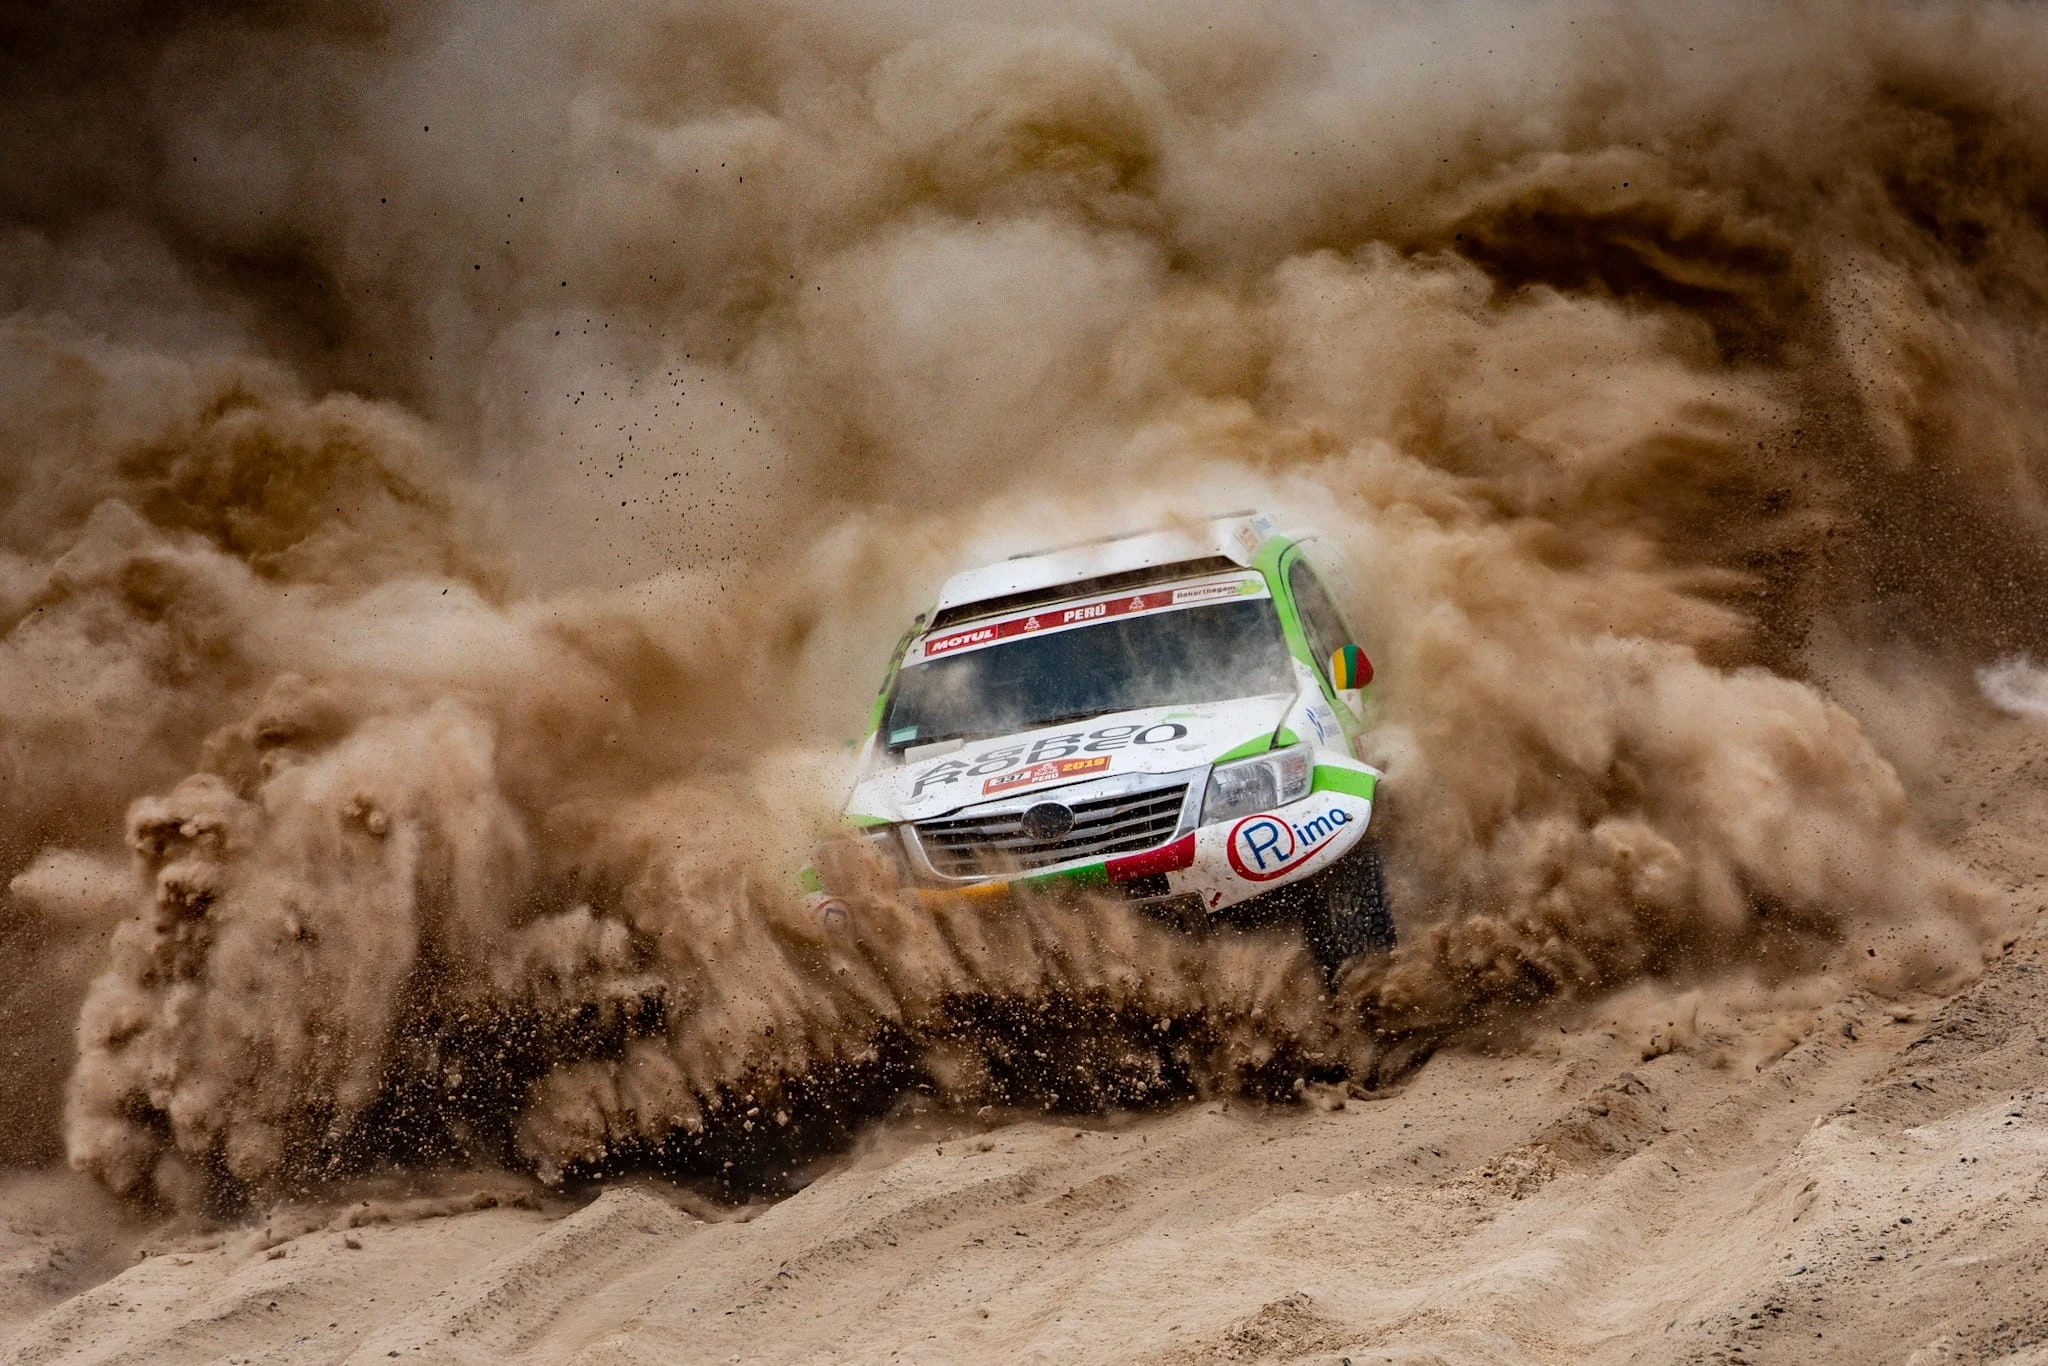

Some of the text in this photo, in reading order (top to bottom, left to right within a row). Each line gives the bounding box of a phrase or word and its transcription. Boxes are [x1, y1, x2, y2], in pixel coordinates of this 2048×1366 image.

[1063, 603, 1106, 622] PERÚ
[931, 629, 994, 652] MOTUL
[911, 724, 1188, 797] RODEO
[996, 774, 1024, 785] 337
